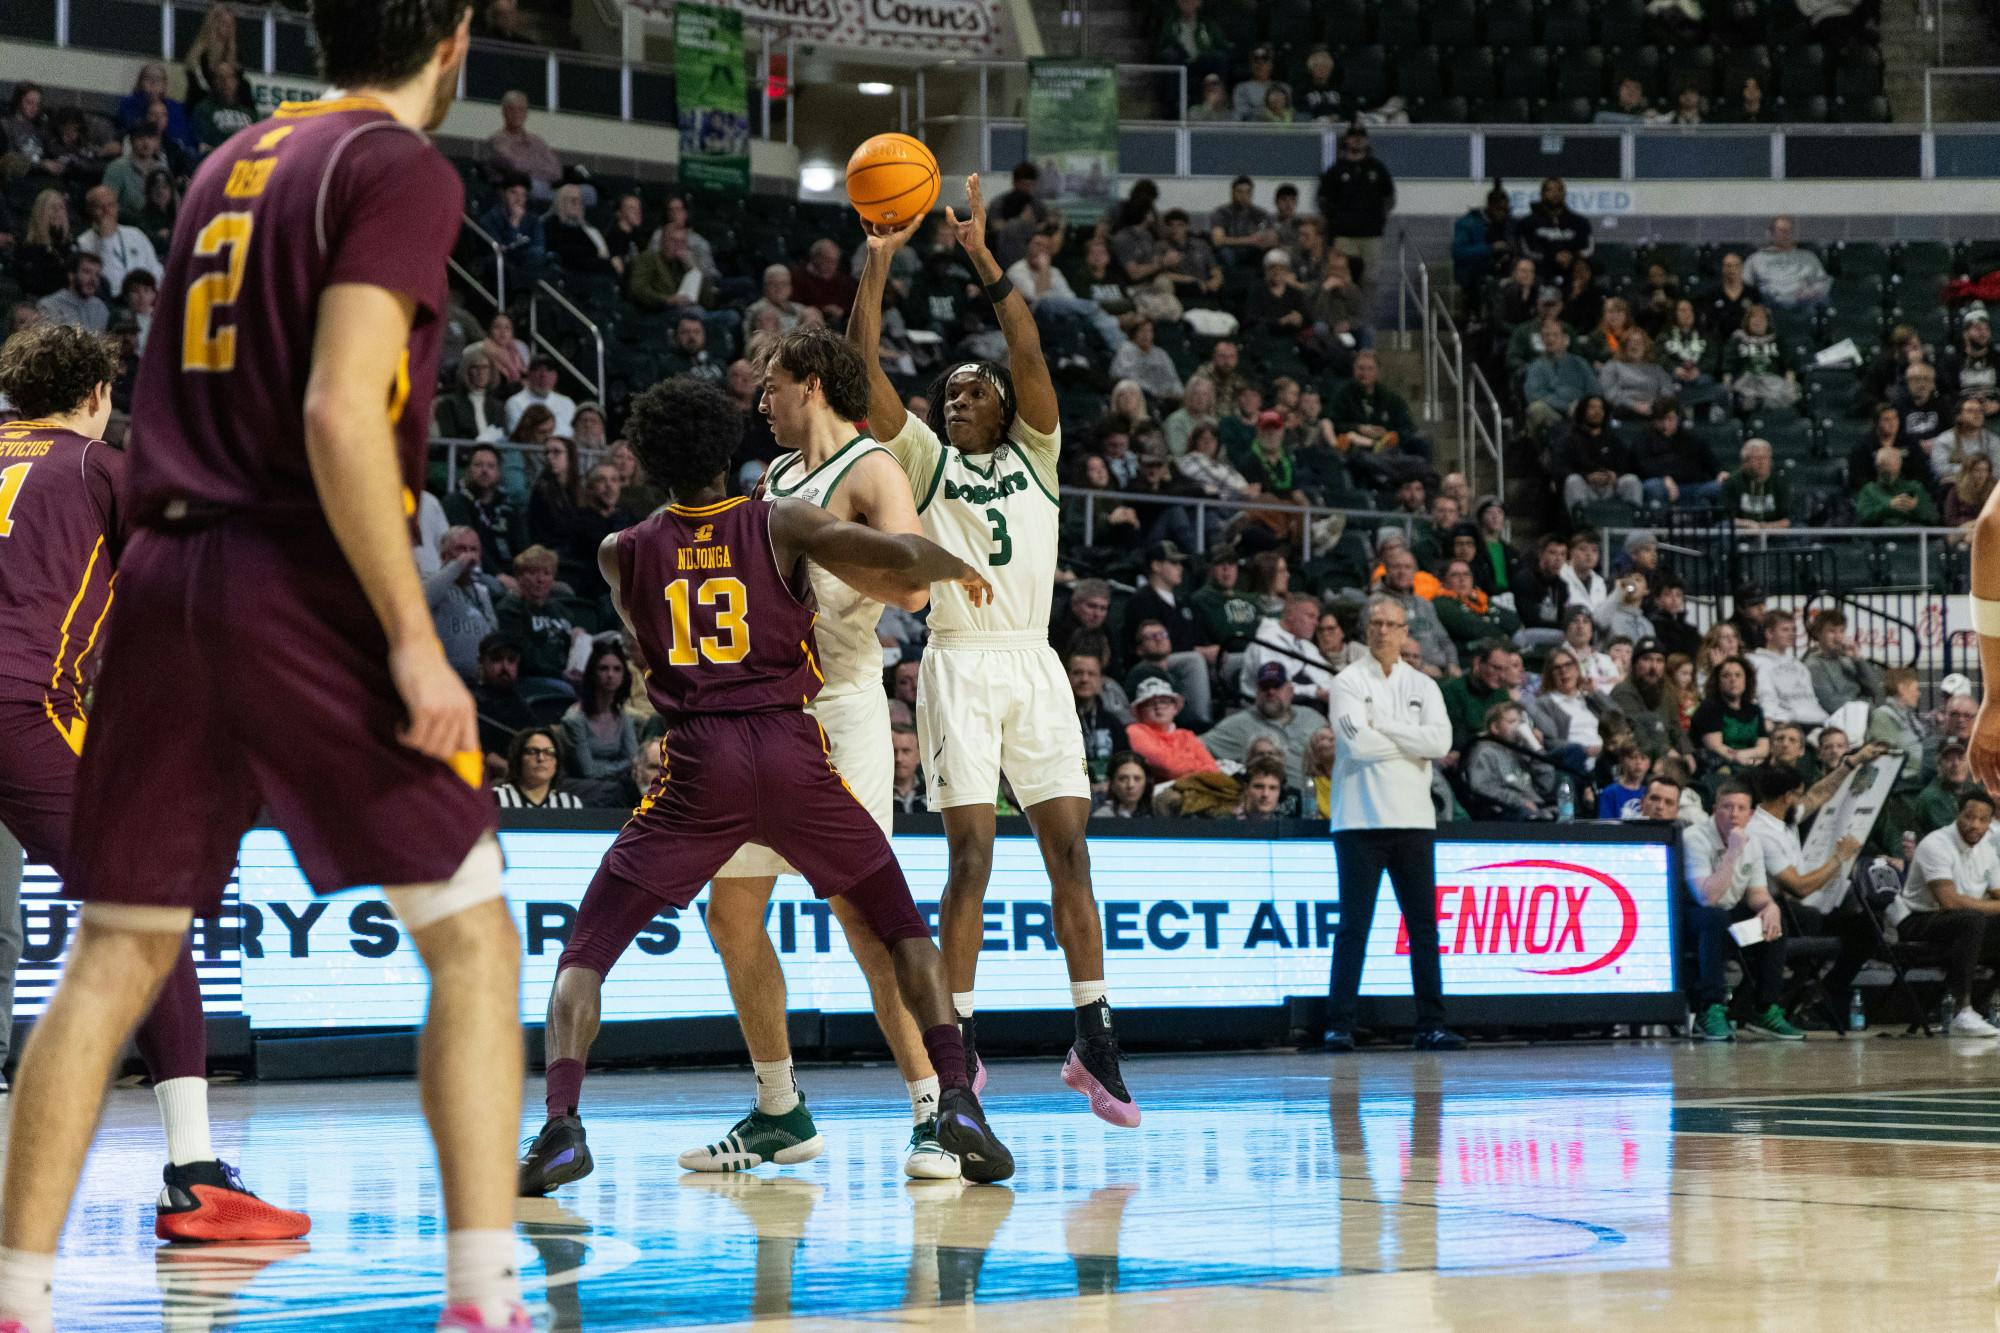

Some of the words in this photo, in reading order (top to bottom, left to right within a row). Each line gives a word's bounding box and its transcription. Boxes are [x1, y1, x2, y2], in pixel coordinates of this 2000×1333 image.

[743, 0, 830, 18] onns
[871, 0, 978, 31] Conn's
[255, 84, 321, 105] ESER
[1510, 190, 1631, 210] ERVED
[182, 211, 254, 372] 2
[986, 507, 1012, 567] 3
[677, 544, 732, 571] NDJONGA
[664, 576, 751, 666] 13
[916, 901, 1229, 951] ERECT
